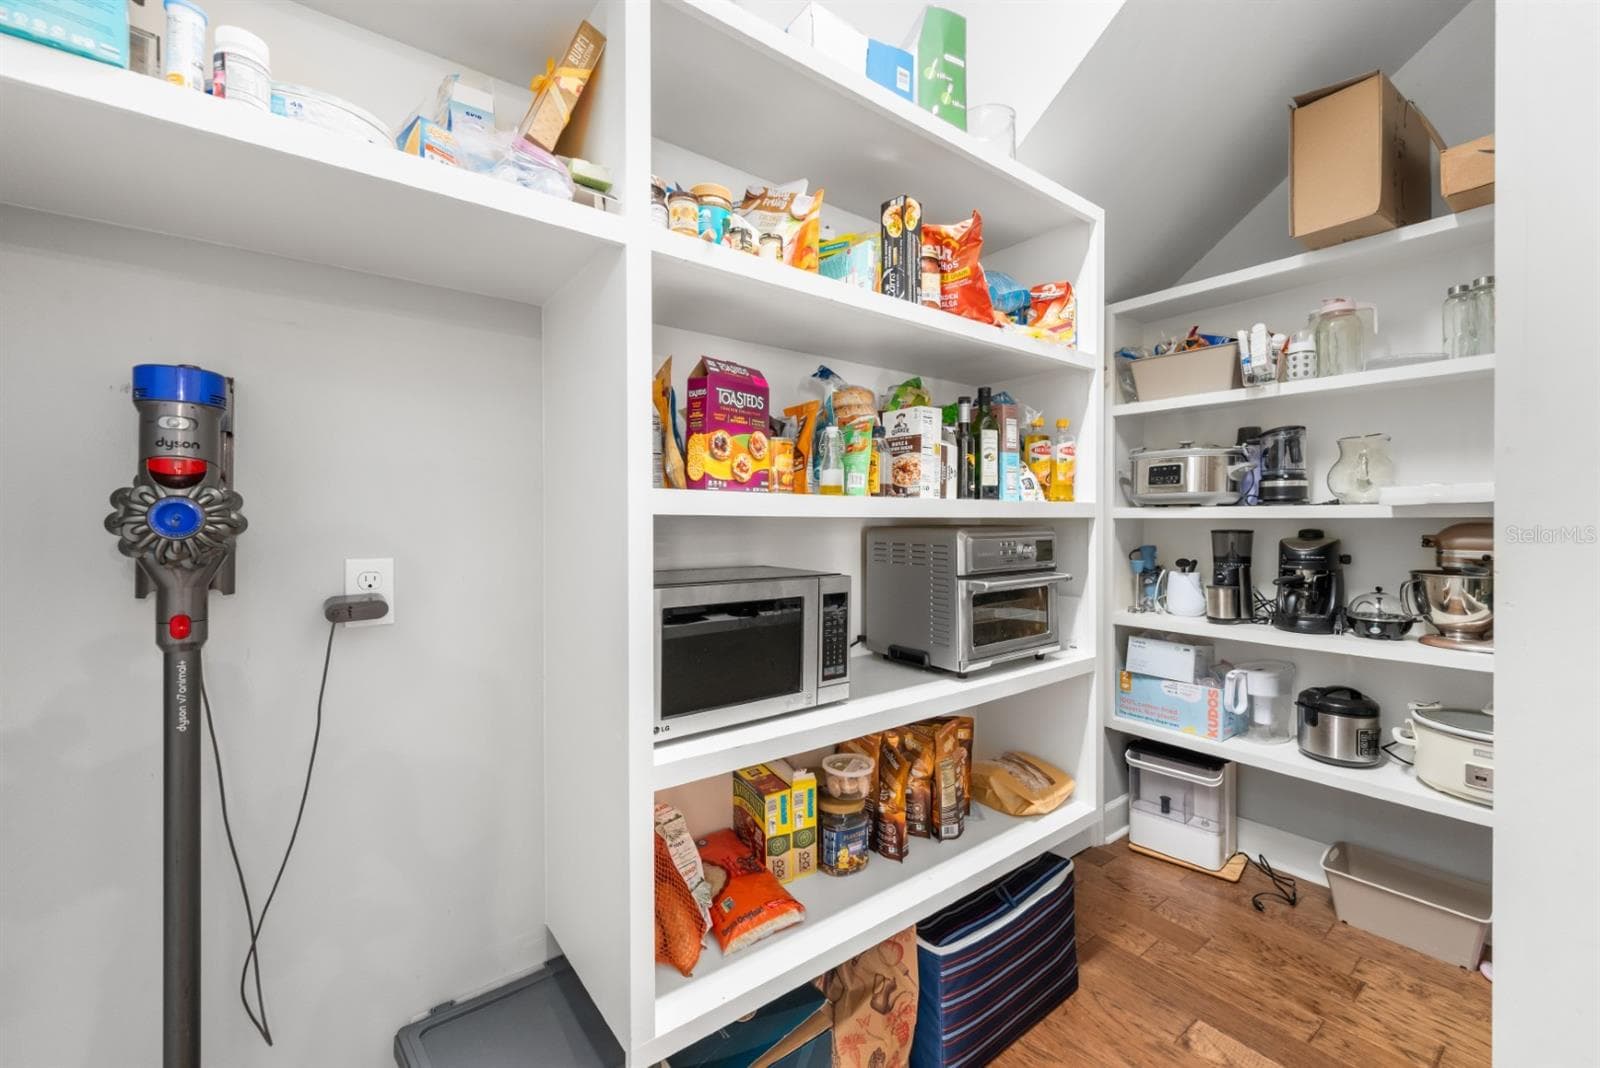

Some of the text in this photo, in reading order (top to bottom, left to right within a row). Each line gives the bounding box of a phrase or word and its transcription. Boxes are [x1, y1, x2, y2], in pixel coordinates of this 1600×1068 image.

[716, 386, 765, 411] TOASTEDS
[155, 436, 201, 451] dyson
[176, 694, 187, 704] v7
[176, 705, 190, 732] dyson
[1207, 688, 1219, 738] KUDOS
[661, 725, 670, 733] LG
